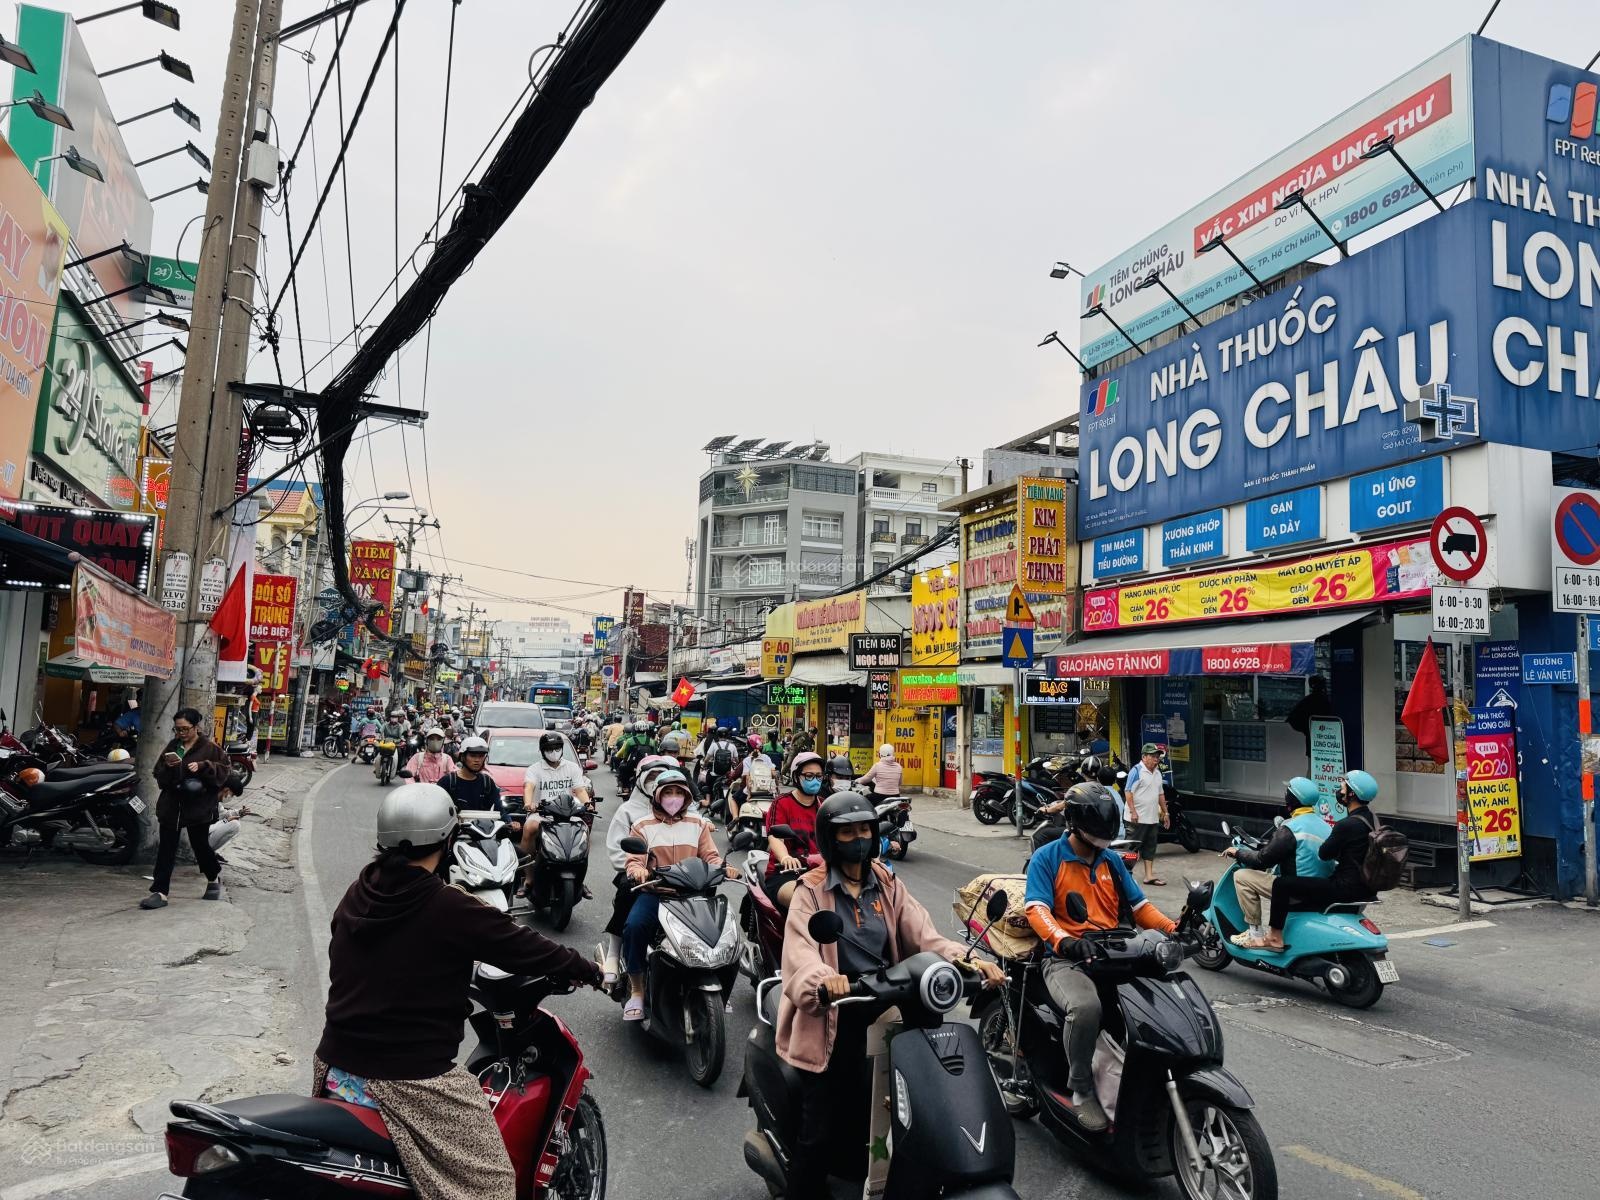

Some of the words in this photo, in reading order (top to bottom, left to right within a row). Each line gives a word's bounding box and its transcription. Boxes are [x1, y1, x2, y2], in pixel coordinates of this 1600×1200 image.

[1555, 138, 1577, 159] FPT
[1237, 198, 1268, 228] XIN
[1332, 131, 1379, 171] UNG
[1383, 93, 1435, 137] THƯ
[1486, 167, 1557, 217] NHÀ
[1274, 215, 1288, 228] Do
[1289, 205, 1299, 220] Vi
[1319, 184, 1341, 202] HPV
[1344, 201, 1379, 229] 1800
[1299, 229, 1321, 246] Minh
[1109, 267, 1130, 289] TIÊM
[1109, 276, 1146, 308] LONG
[1150, 342, 1209, 401] NHÀ
[1218, 285, 1338, 368] THUỐC
[1492, 316, 1600, 400] CH
[1089, 408, 1223, 501] LONG
[1243, 318, 1449, 449] CHÂU
[1371, 481, 1386, 498] DỊ
[1388, 474, 1417, 491] ỨNG
[1270, 500, 1293, 515] GAN
[1377, 501, 1413, 519] GOUT
[1033, 507, 1057, 527] KIM
[72, 519, 145, 547] QUAY
[1164, 524, 1194, 542] XƯƠNG
[1195, 518, 1221, 536] KHỚP
[1263, 525, 1278, 540] DẠ
[1279, 519, 1301, 535] DÀY
[355, 544, 391, 562] TIỆM
[1029, 532, 1061, 556] PHÁT
[1100, 539, 1113, 553] TIM
[1113, 536, 1136, 554] MẠCH
[1190, 540, 1214, 556] KINH
[1112, 555, 1139, 569] ĐƯỜNG
[1299, 564, 1314, 575] ĐO
[1315, 556, 1346, 571] HUYẾT
[1347, 555, 1361, 567] ÁP
[353, 563, 391, 581] VÀNG
[1026, 561, 1064, 587] THỊNH
[255, 578, 273, 602] ĐỔI
[277, 582, 292, 603] SỐ
[1088, 609, 1113, 626] 2026
[250, 624, 268, 637] ĐẶC
[270, 625, 290, 638] BIỆT
[857, 638, 880, 651] TIỆM
[880, 638, 897, 651] BẠC
[855, 654, 877, 668] NGỌC
[1059, 658, 1083, 673] GIAO
[1084, 653, 1115, 671] HÀNG
[1116, 654, 1140, 674] TẬN
[1140, 655, 1162, 670] NƠI
[1206, 658, 1231, 670] 1800
[1232, 657, 1261, 670] 6928
[1533, 656, 1563, 667] ĐƯỜNG
[1525, 669, 1536, 681] LÊ
[1537, 669, 1555, 681] VĂN
[1555, 669, 1572, 683] VIỆT
[872, 682, 889, 693] BẠC
[1477, 711, 1490, 720] NHÀ
[895, 727, 915, 740] BẠC
[1478, 722, 1498, 730] LONG
[894, 742, 916, 754] ITALY
[907, 755, 922, 771] NỘI
[1471, 758, 1508, 778] 2026
[1469, 783, 1497, 795] HÀNG
[1491, 796, 1510, 806] ANH
